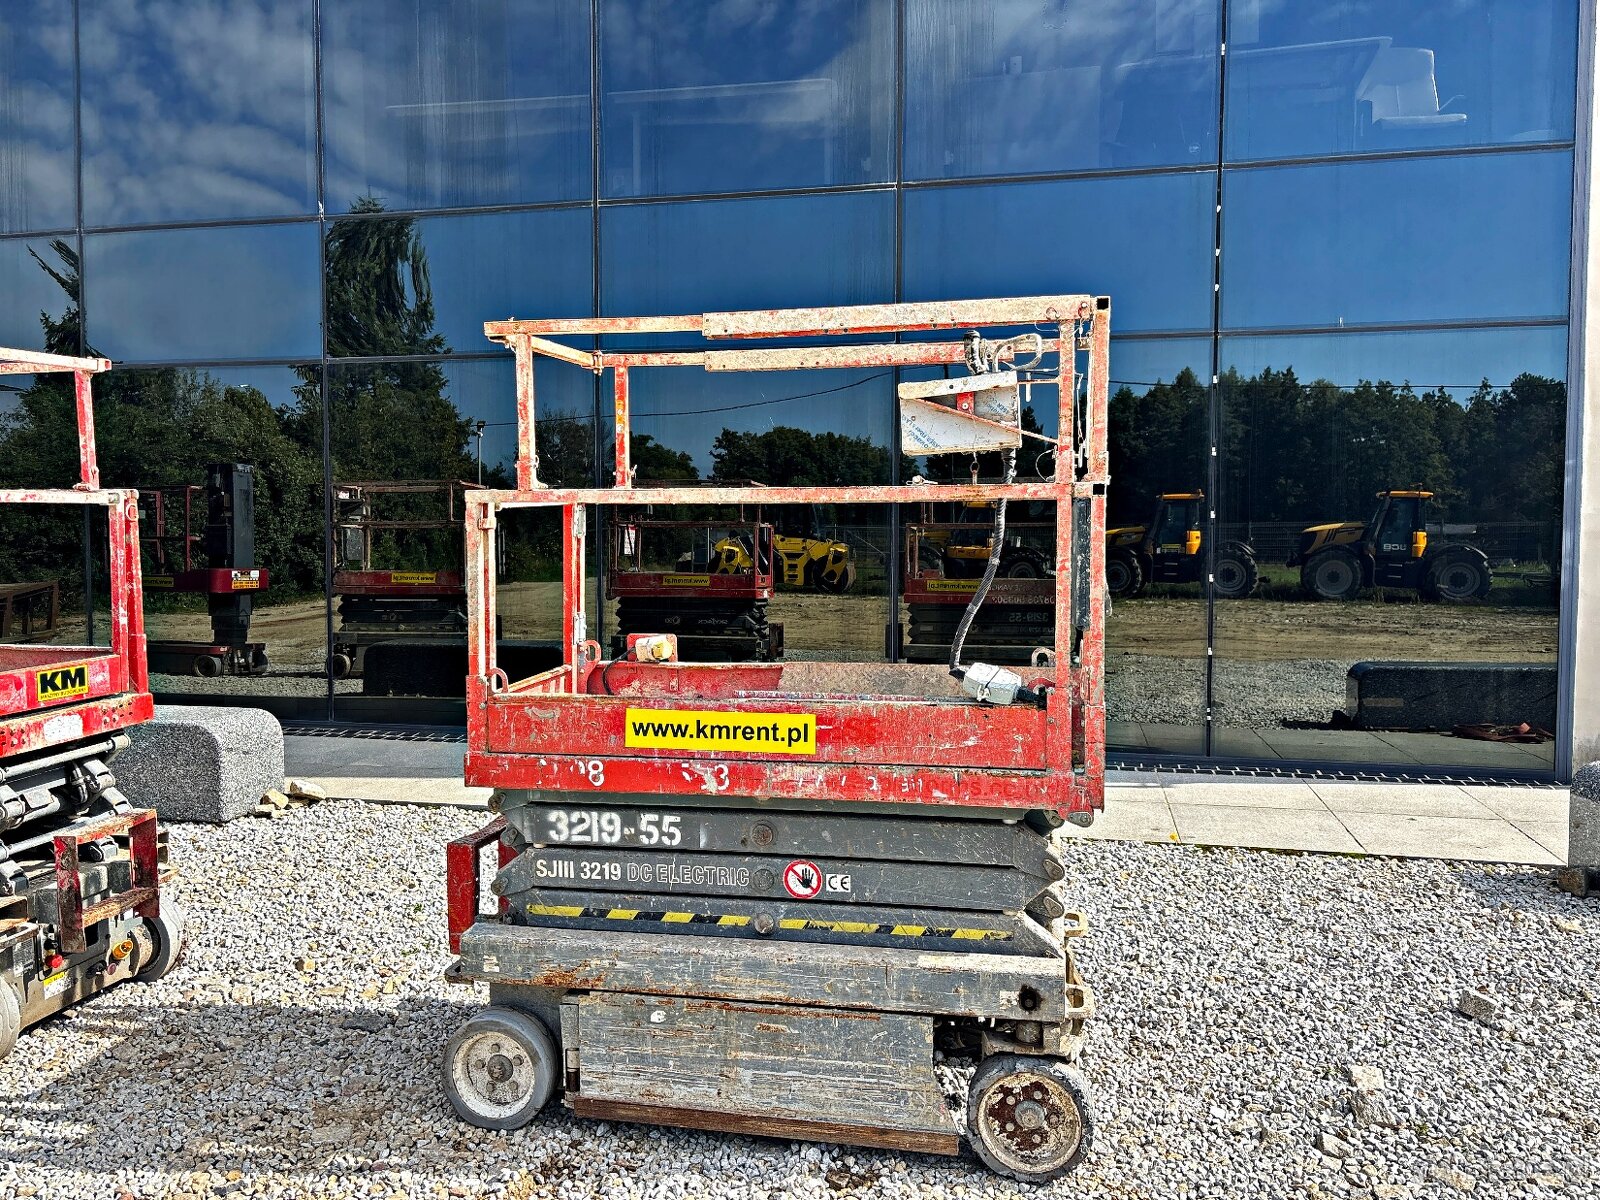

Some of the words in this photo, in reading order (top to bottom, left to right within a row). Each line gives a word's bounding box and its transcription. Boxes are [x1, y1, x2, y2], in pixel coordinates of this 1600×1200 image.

[40, 667, 86, 694] KM
[631, 719, 810, 748] www.kmrent.pl
[548, 809, 682, 846] 3219-55
[536, 859, 575, 879] SJIII
[580, 861, 622, 881] 3219
[626, 862, 653, 882] DC
[656, 863, 750, 887] ELECTRIC
[828, 874, 850, 892] CE
